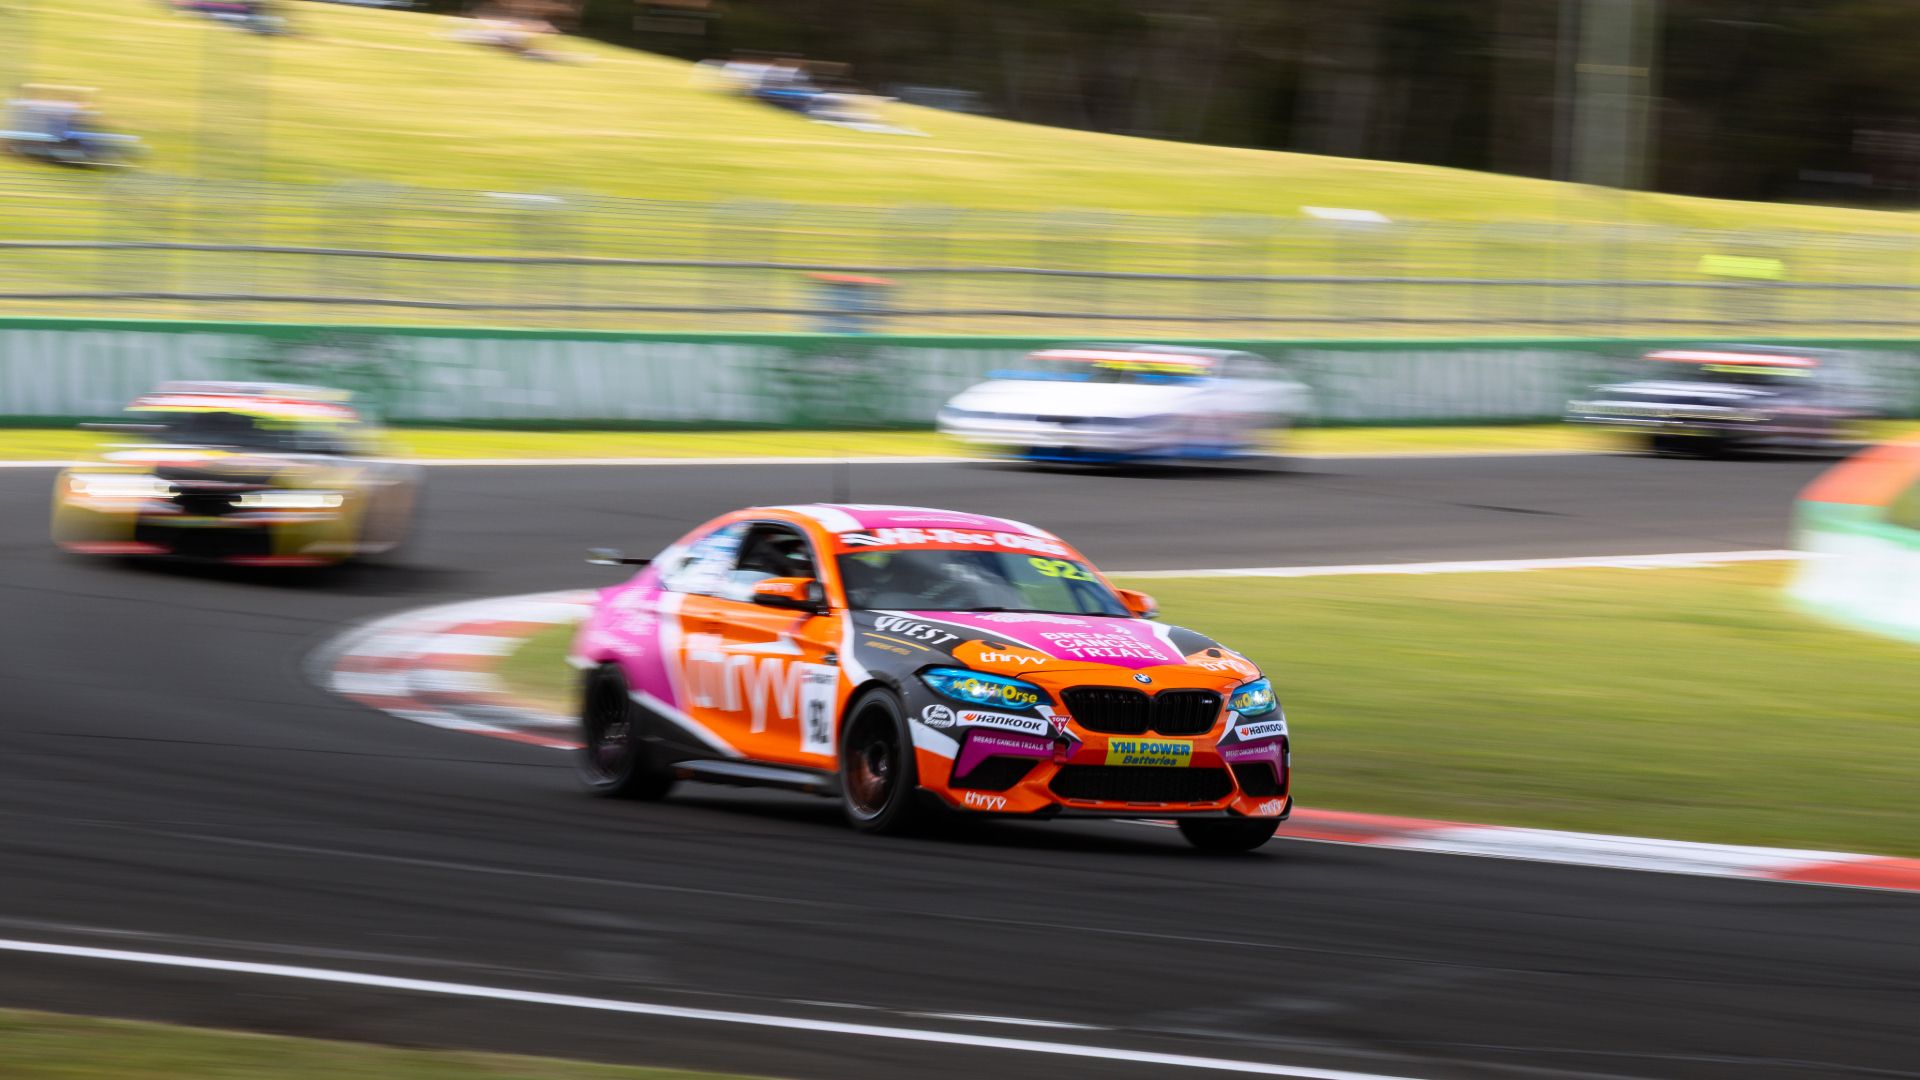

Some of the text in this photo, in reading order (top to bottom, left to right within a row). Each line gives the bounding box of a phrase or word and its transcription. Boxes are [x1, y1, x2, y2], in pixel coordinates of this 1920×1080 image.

[876, 528, 1068, 556] Hi-Tec Oils
[873, 615, 959, 645] QUEST
[1040, 632, 1140, 643] BREAST
[1054, 639, 1156, 651] CANCER
[980, 652, 1046, 665] thryv
[1066, 647, 1168, 661] TRIALS
[973, 735, 1043, 751] BREAST CANCER TRIALS
[1111, 741, 1191, 756] YHI POWER
[1123, 755, 1178, 766] Batteries
[965, 791, 1007, 810] thryv
